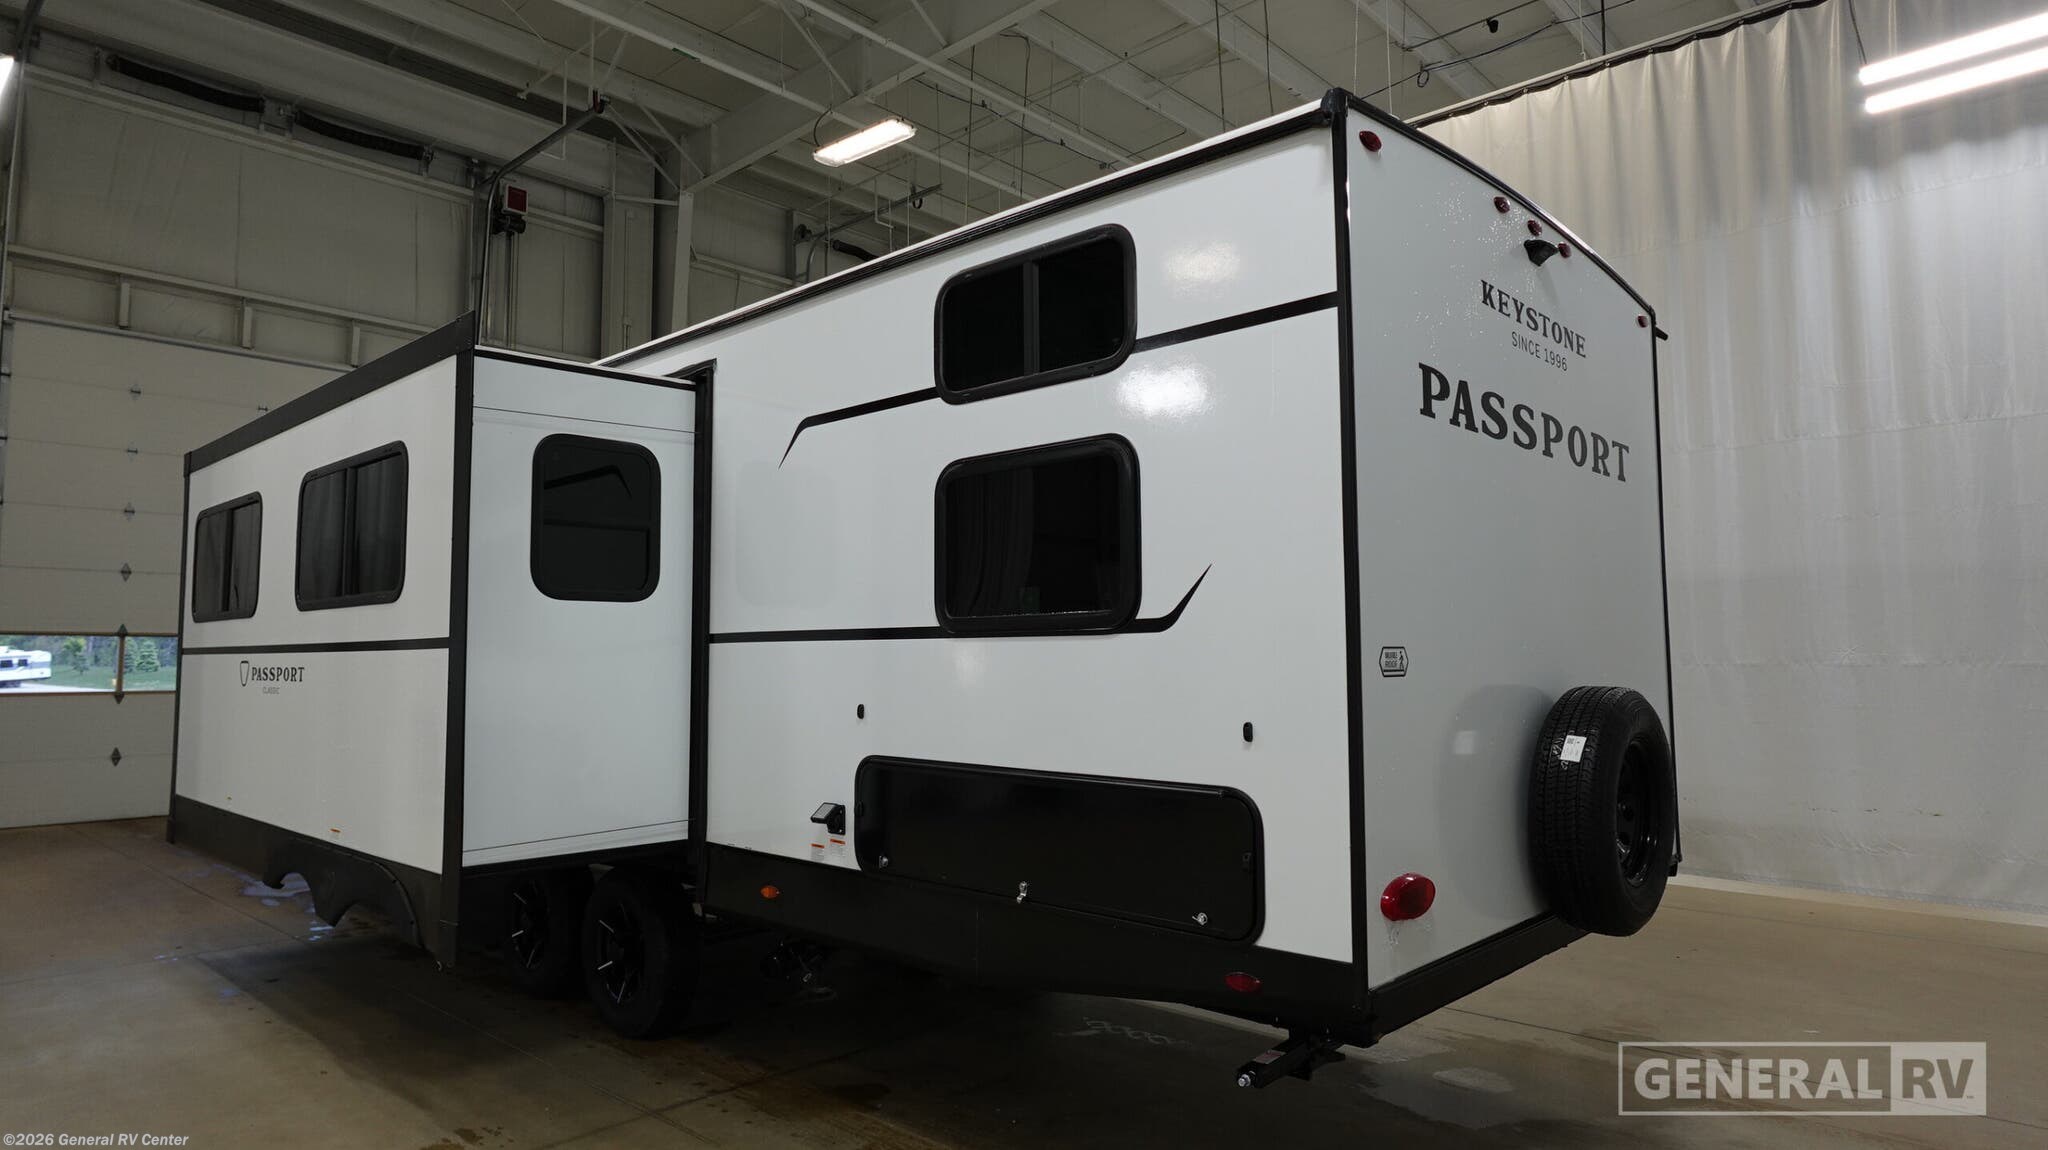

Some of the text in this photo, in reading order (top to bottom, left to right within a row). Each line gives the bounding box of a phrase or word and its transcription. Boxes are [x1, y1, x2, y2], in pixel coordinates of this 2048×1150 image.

[1480, 279, 1587, 358] KEYSTONE
[1511, 331, 1568, 372] SINCE 1996
[1418, 362, 1630, 482] PASSPORT
[251, 667, 305, 682] PASSPORT
